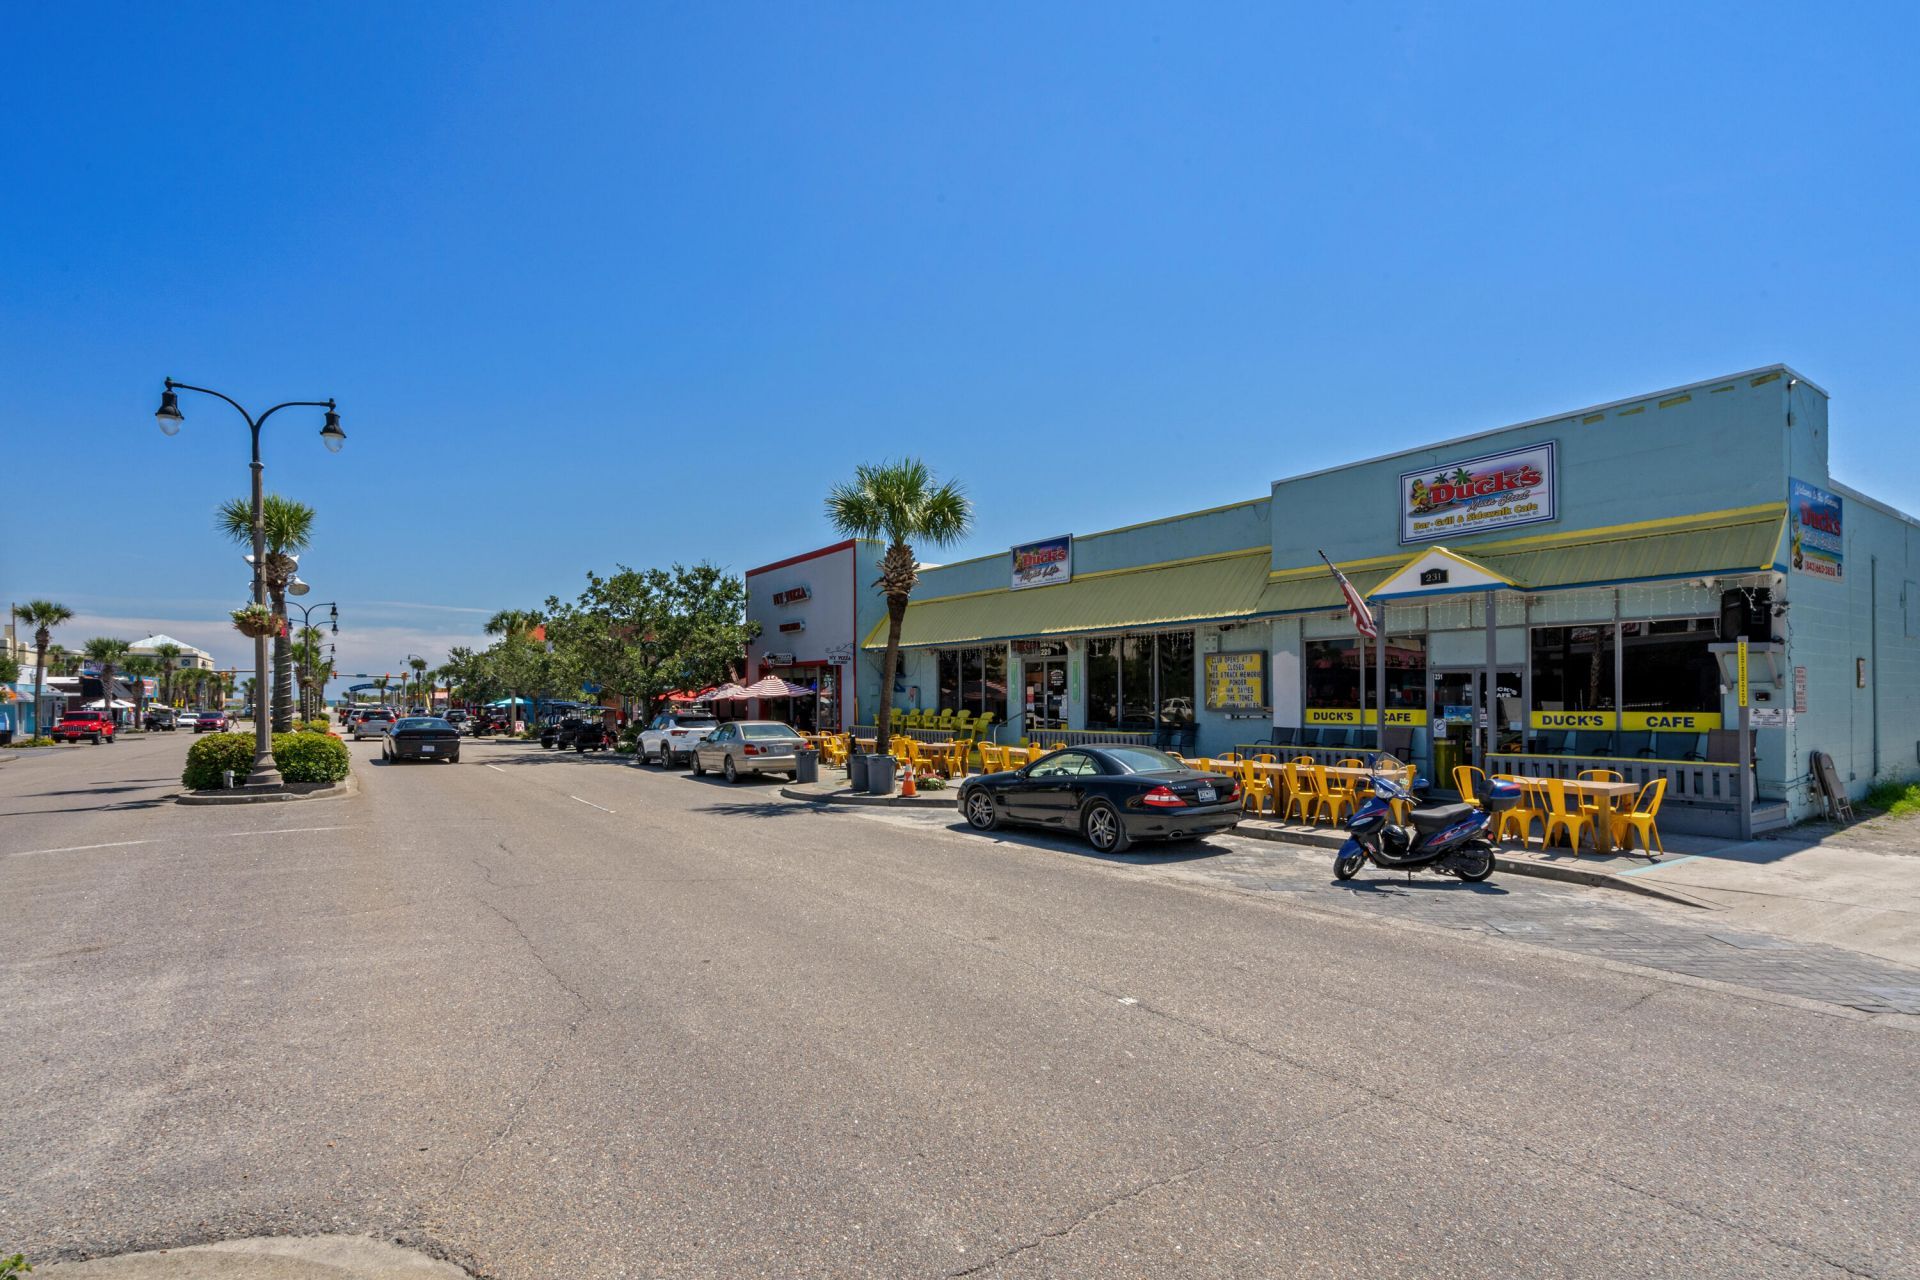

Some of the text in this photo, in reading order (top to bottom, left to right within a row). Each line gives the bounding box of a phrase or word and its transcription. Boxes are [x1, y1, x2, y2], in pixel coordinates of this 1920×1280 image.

[1429, 464, 1543, 504] Duck's
[1466, 505, 1513, 522] Sidewalk
[1513, 502, 1539, 514] Cafe
[1800, 501, 1840, 536] Duck's
[1023, 545, 1067, 568] Duck's
[1425, 570, 1442, 582] 231
[1313, 711, 1354, 721] DUCK'S
[1542, 714, 1695, 728] DUCK'S CAFE
